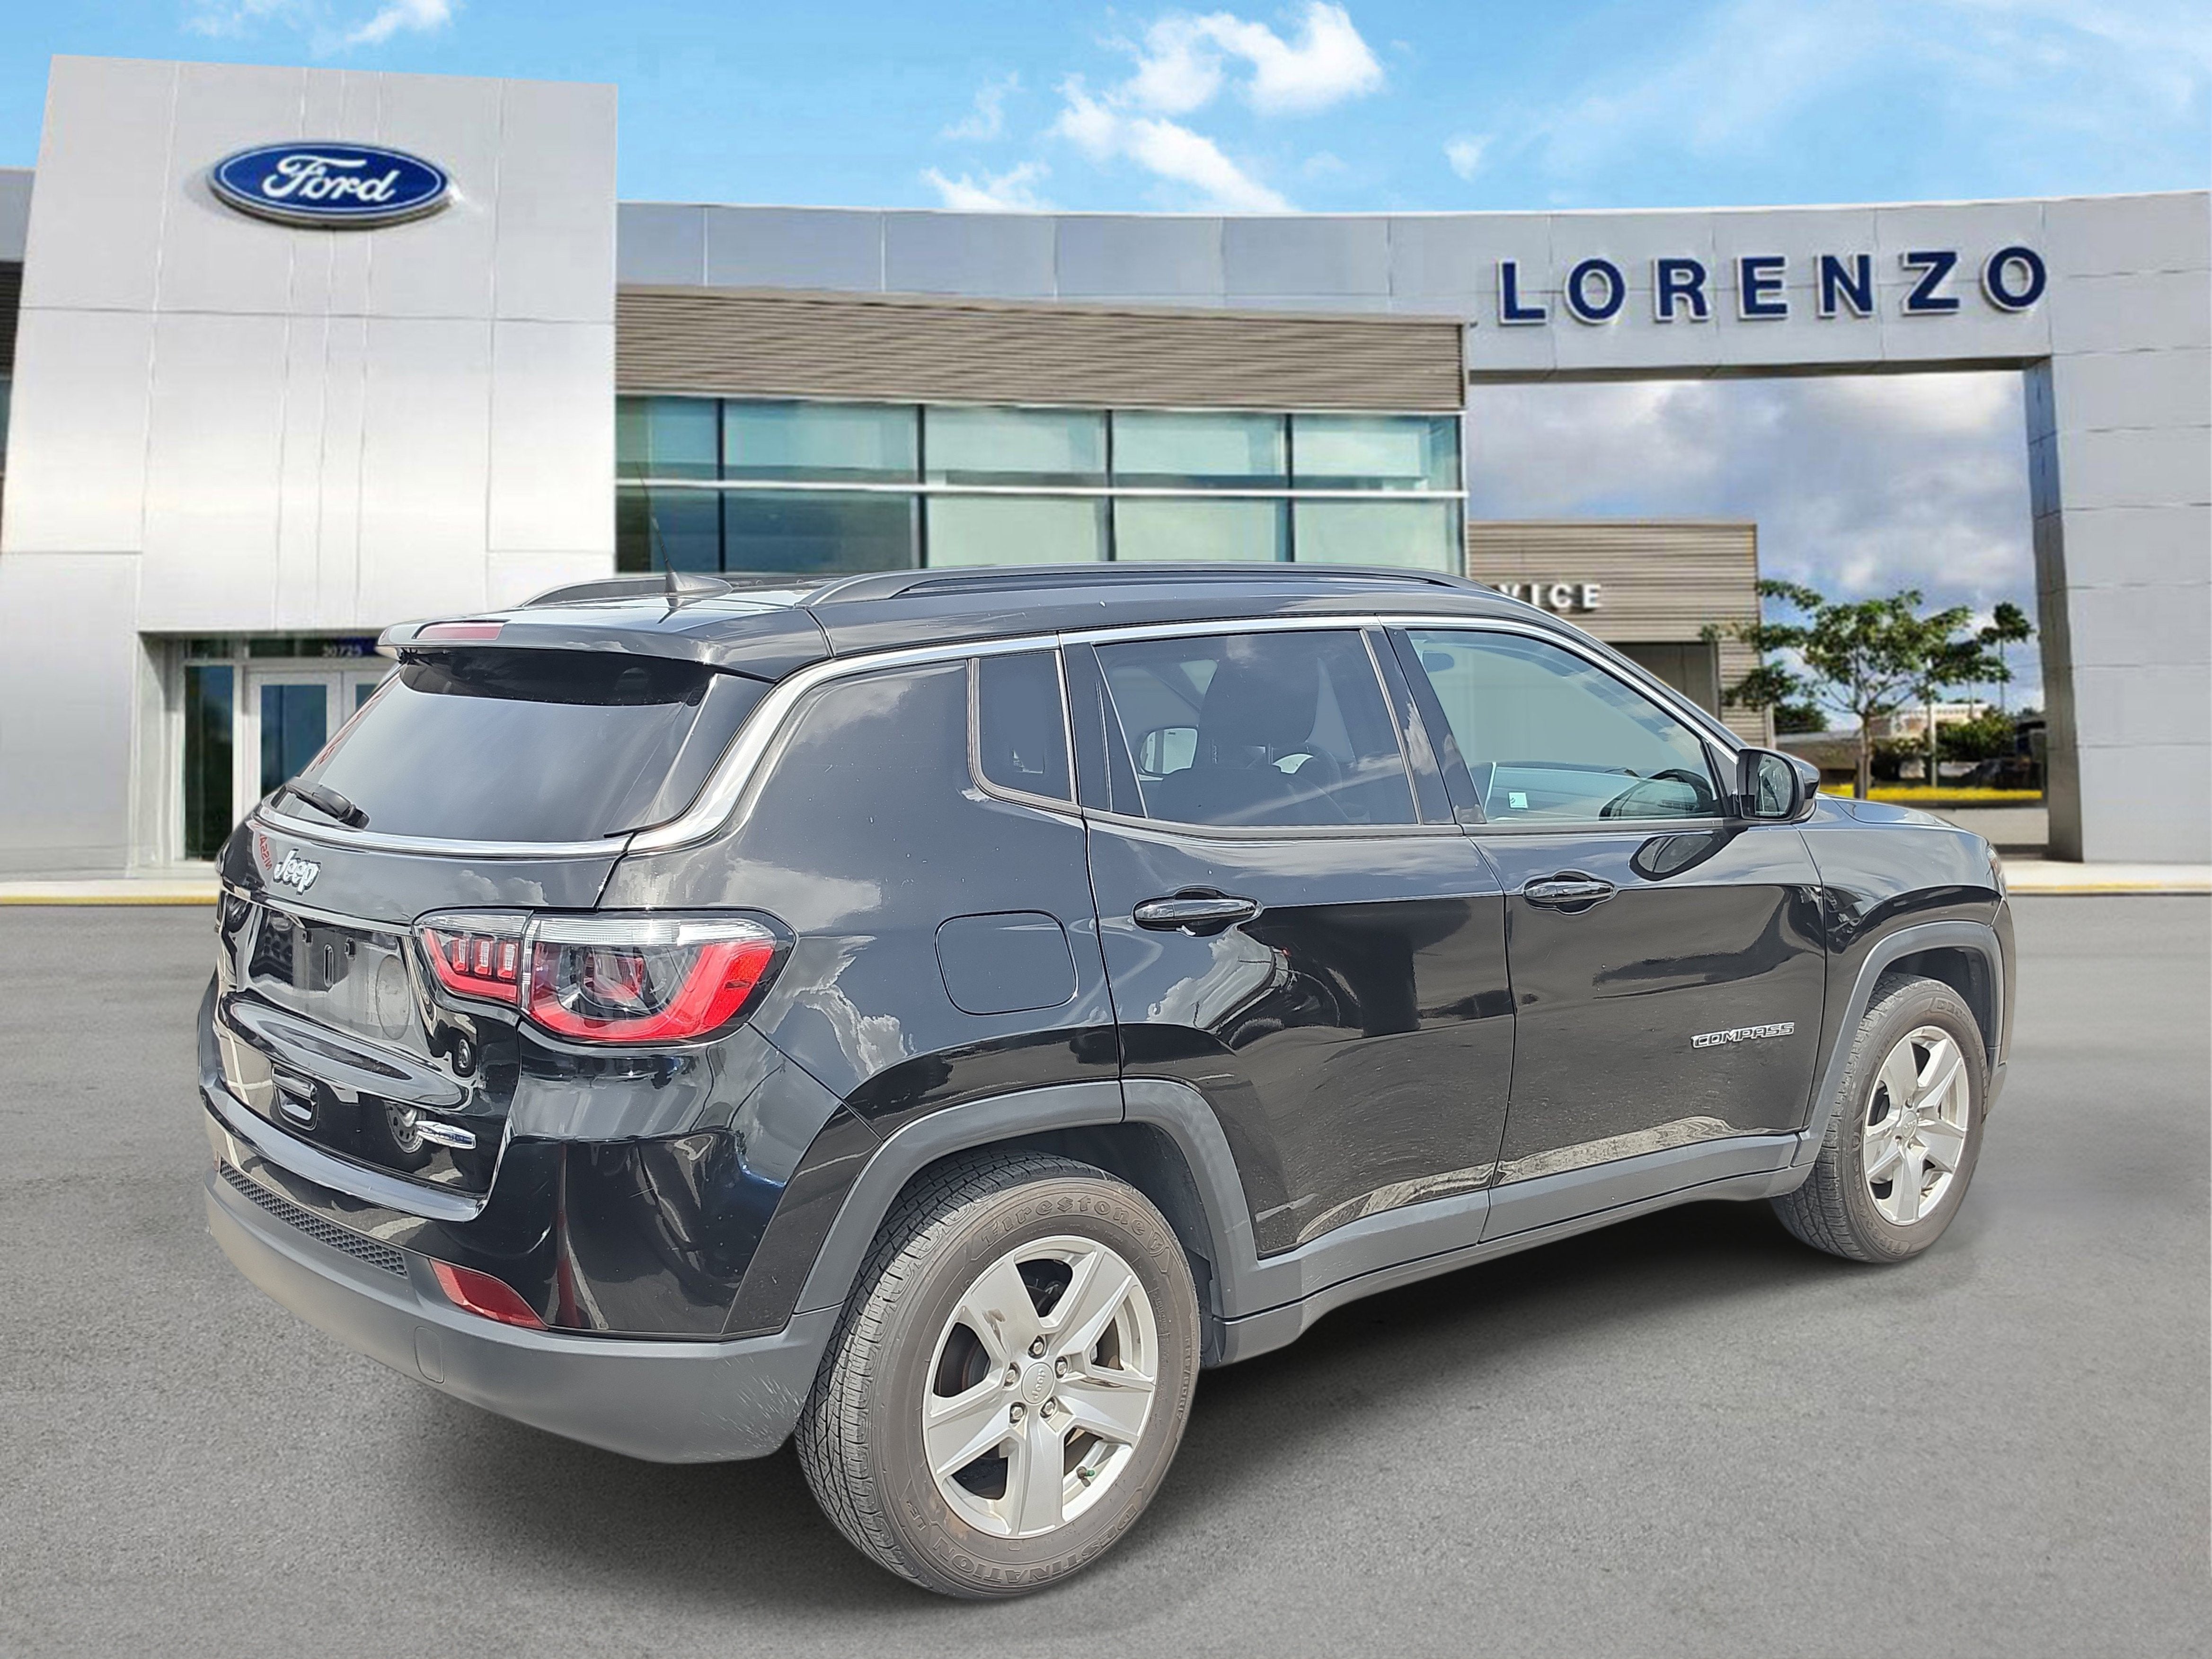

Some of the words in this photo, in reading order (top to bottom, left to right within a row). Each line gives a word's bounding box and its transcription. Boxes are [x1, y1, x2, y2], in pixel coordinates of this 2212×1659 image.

[262, 154, 400, 201] Ford
[1498, 246, 2047, 324] LORENZO
[273, 848, 321, 895] Jeep
[1691, 1021, 1795, 1048] COMPASS
[981, 1196, 1146, 1247] Firestone
[933, 1504, 1137, 1583] DESTINATION
